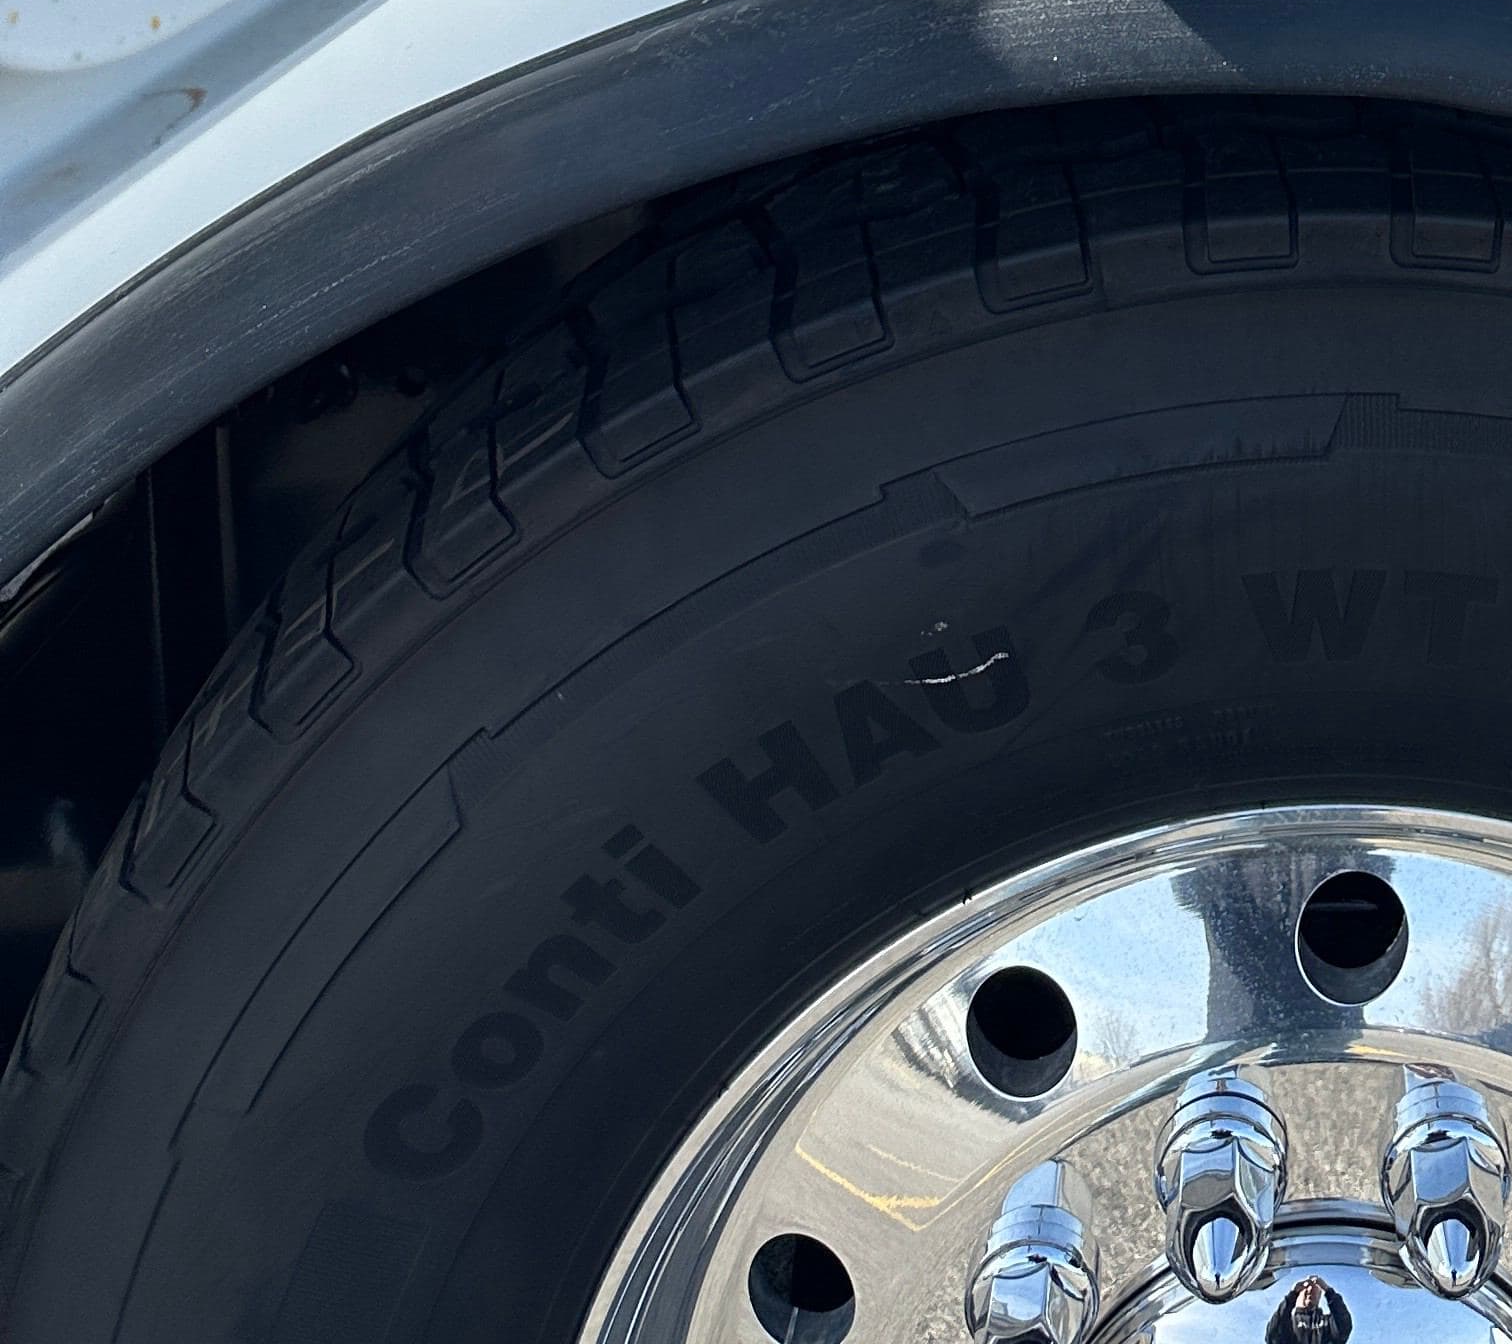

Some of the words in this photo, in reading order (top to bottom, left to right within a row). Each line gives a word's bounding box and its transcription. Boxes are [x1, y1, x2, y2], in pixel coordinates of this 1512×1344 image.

[363, 825, 701, 1183] Conti
[694, 626, 1029, 844] HAU
[1083, 589, 1180, 684] 3
[1240, 570, 1501, 666] WT
